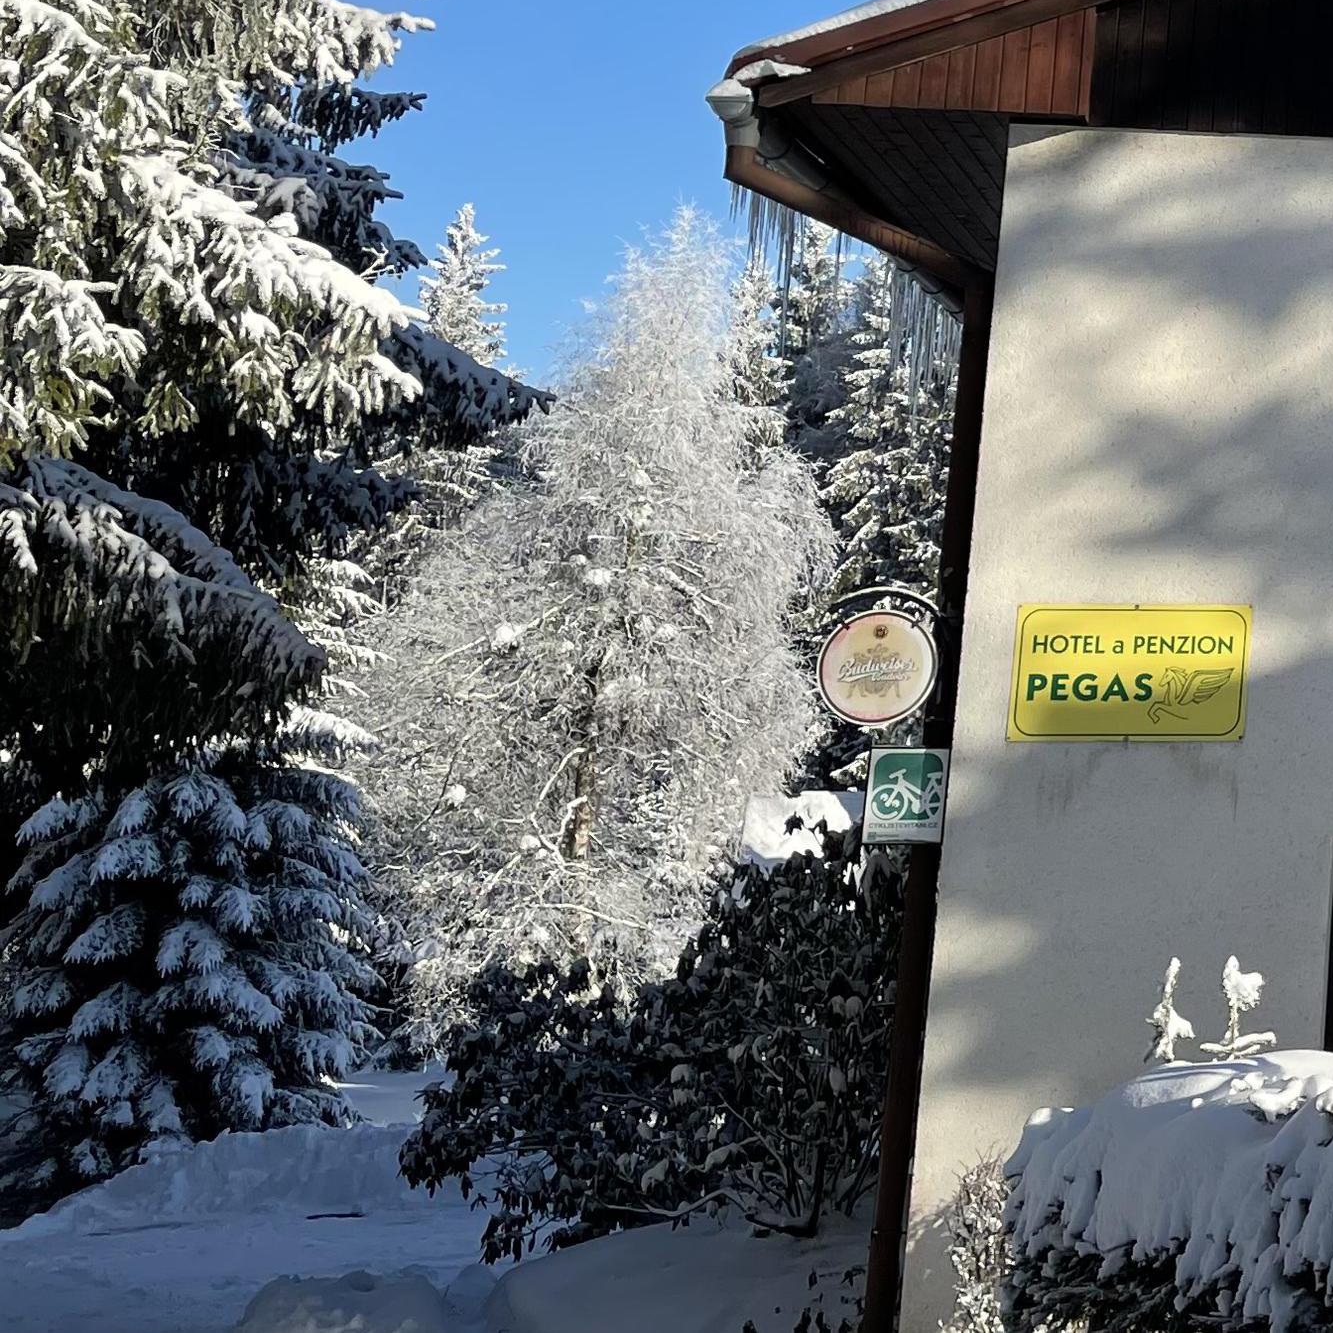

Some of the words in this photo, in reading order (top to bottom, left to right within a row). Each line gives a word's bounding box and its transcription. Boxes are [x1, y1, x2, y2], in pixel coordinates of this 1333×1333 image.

[1032, 634, 1105, 655] HOTEL
[1112, 639, 1124, 655] a
[1133, 635, 1234, 656] PENZION
[838, 658, 919, 682] Budweiser
[1026, 673, 1154, 703] PEGAS
